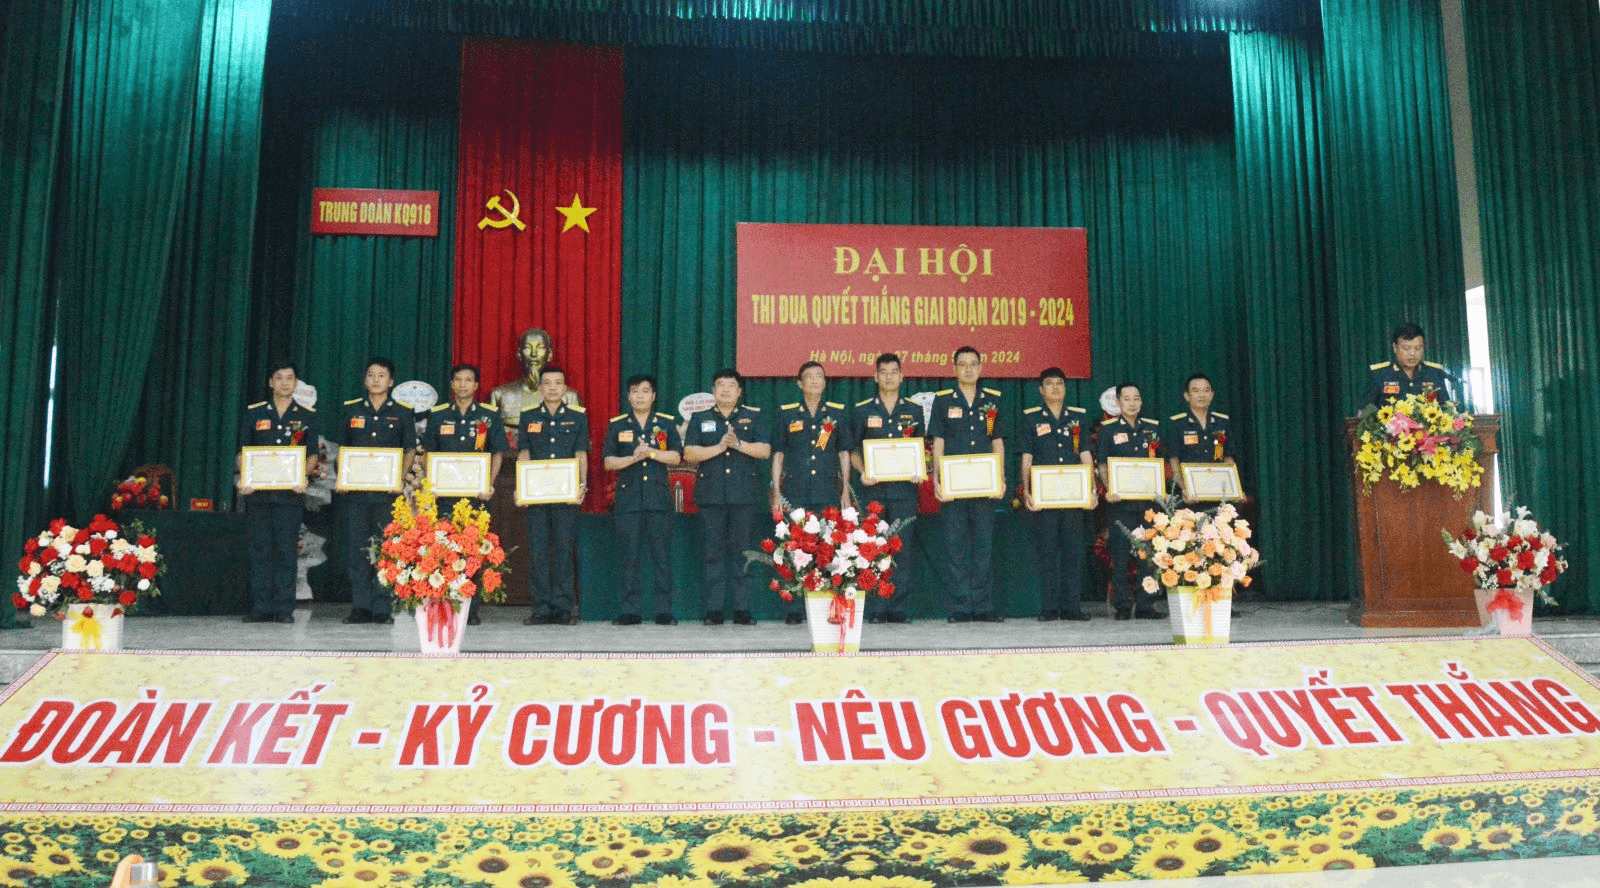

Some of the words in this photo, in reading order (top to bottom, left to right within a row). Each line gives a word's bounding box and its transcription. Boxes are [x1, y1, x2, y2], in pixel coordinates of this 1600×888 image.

[319, 201, 357, 223] TRUNG
[359, 198, 393, 224] ĐOÀN
[394, 202, 431, 227] KQ916
[833, 246, 907, 283] ĐẠI
[918, 243, 993, 284] HỘI
[751, 294, 775, 325] THI
[778, 294, 809, 325] ĐUA
[811, 285, 859, 328] QUYẾT
[861, 284, 911, 326] THẮNG
[914, 295, 944, 326] GIAI
[947, 296, 988, 333] ĐOẠN
[991, 296, 1027, 326] 2019
[1039, 297, 1076, 327] 2024
[808, 349, 827, 363] Hà
[830, 349, 855, 365] Nội,
[859, 350, 882, 366] ng
[911, 351, 947, 366] tháng
[991, 351, 1021, 364] 2024
[0, 689, 211, 764] ĐOÀN
[207, 684, 349, 765] KẾT
[398, 684, 493, 766] KỶ
[507, 698, 731, 766] CƯƠNG
[795, 689, 927, 762] NÊU
[940, 692, 1166, 760] GƯƠNG
[1204, 670, 1404, 756] QUYẾT
[1386, 662, 1600, 740] THẮNG
